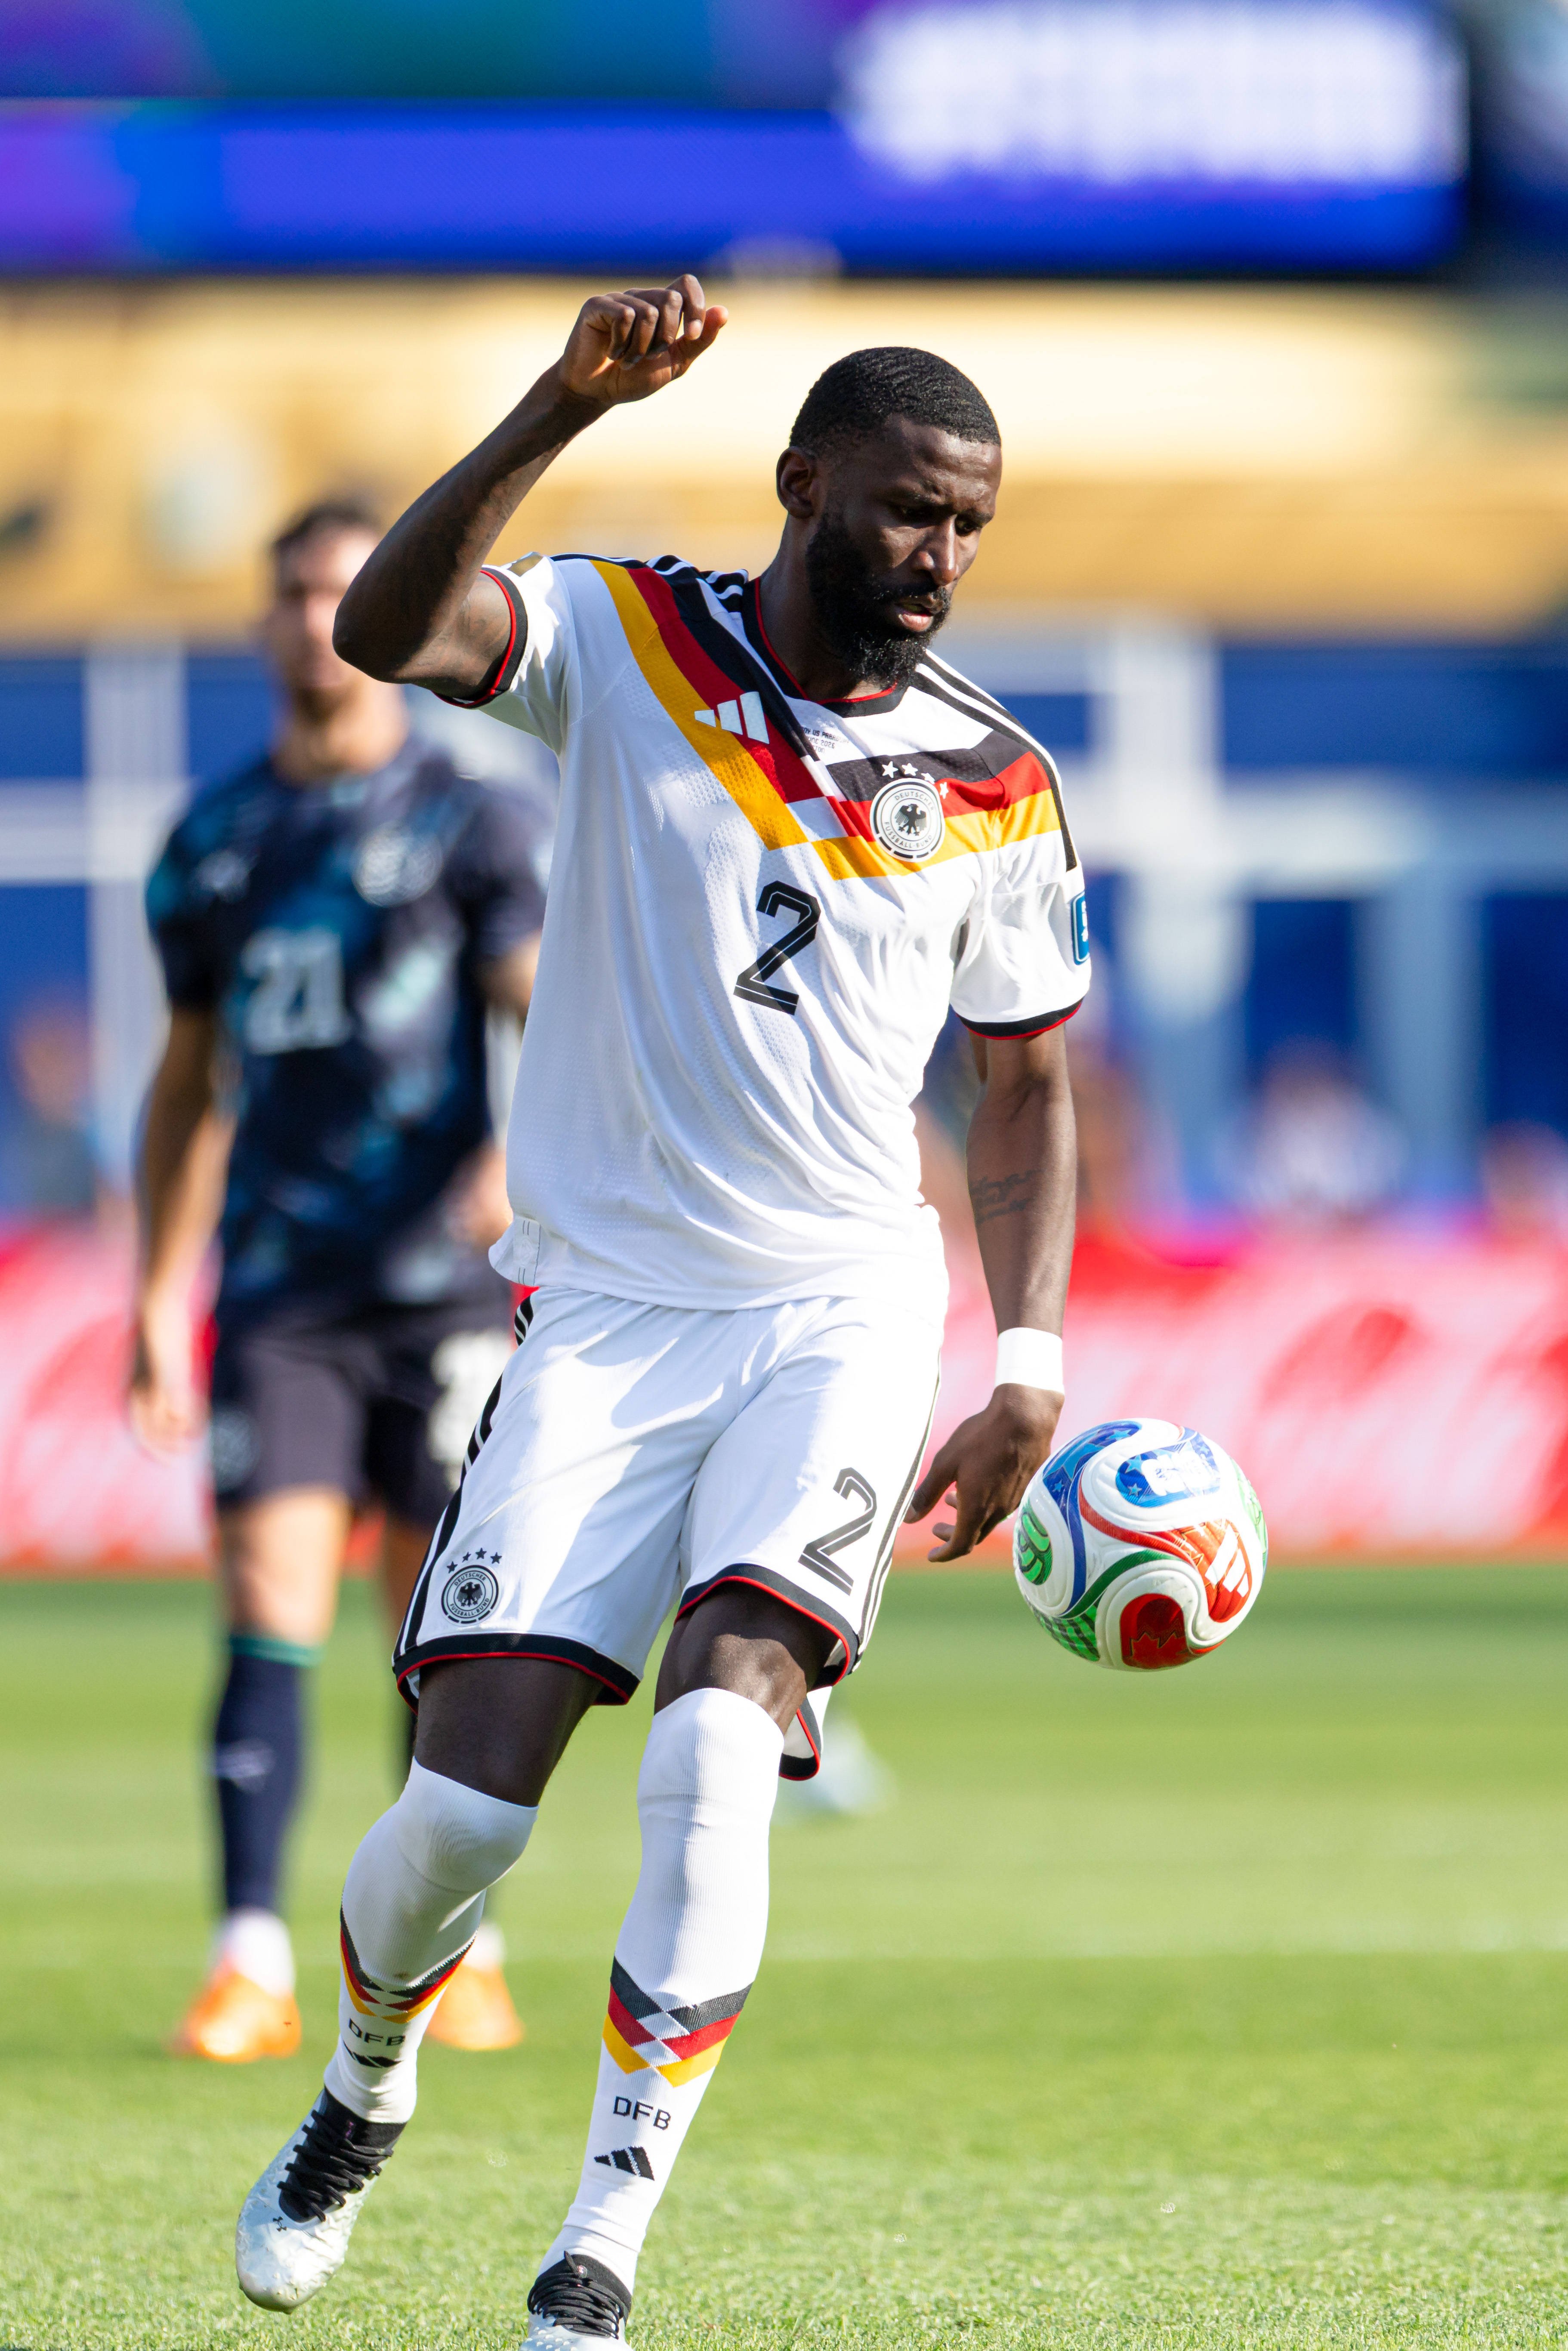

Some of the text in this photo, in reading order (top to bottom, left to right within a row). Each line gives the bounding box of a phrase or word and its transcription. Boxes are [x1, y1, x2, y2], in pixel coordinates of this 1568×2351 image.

[821, 740, 835, 749] 2026
[895, 791, 935, 811] DEUTSCHER
[733, 880, 821, 1015] 2
[241, 926, 348, 1055] 21
[798, 1467, 877, 1596] 2
[454, 1572, 487, 1586] DEUTSCHER
[450, 1597, 490, 1617] FUSSBALL-BUND
[349, 2018, 406, 2046] DFB
[613, 2096, 671, 2130] DFB
